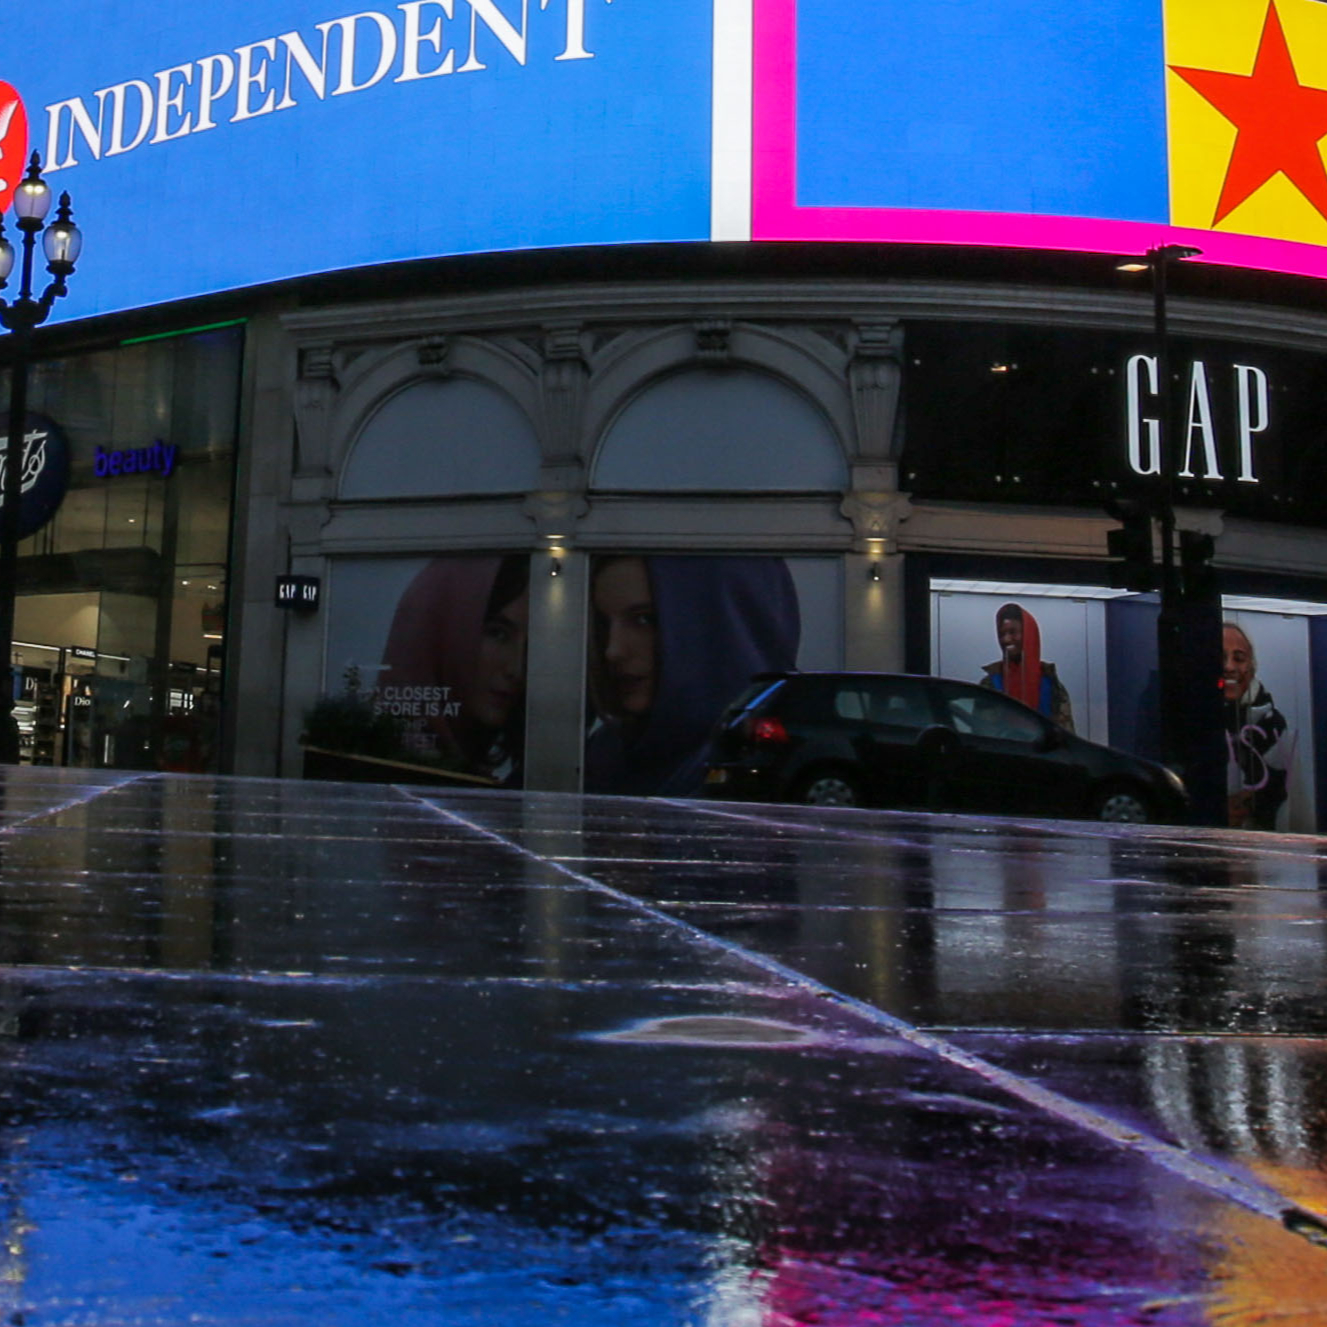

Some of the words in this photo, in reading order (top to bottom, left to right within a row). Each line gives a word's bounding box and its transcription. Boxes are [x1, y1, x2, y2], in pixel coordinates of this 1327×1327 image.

[1126, 354, 1270, 483] GAP
[94, 439, 178, 478] beauty
[384, 686, 451, 701] CLOSEST
[373, 701, 421, 717] STORE
[425, 702, 440, 717] IS
[443, 702, 462, 718] AT
